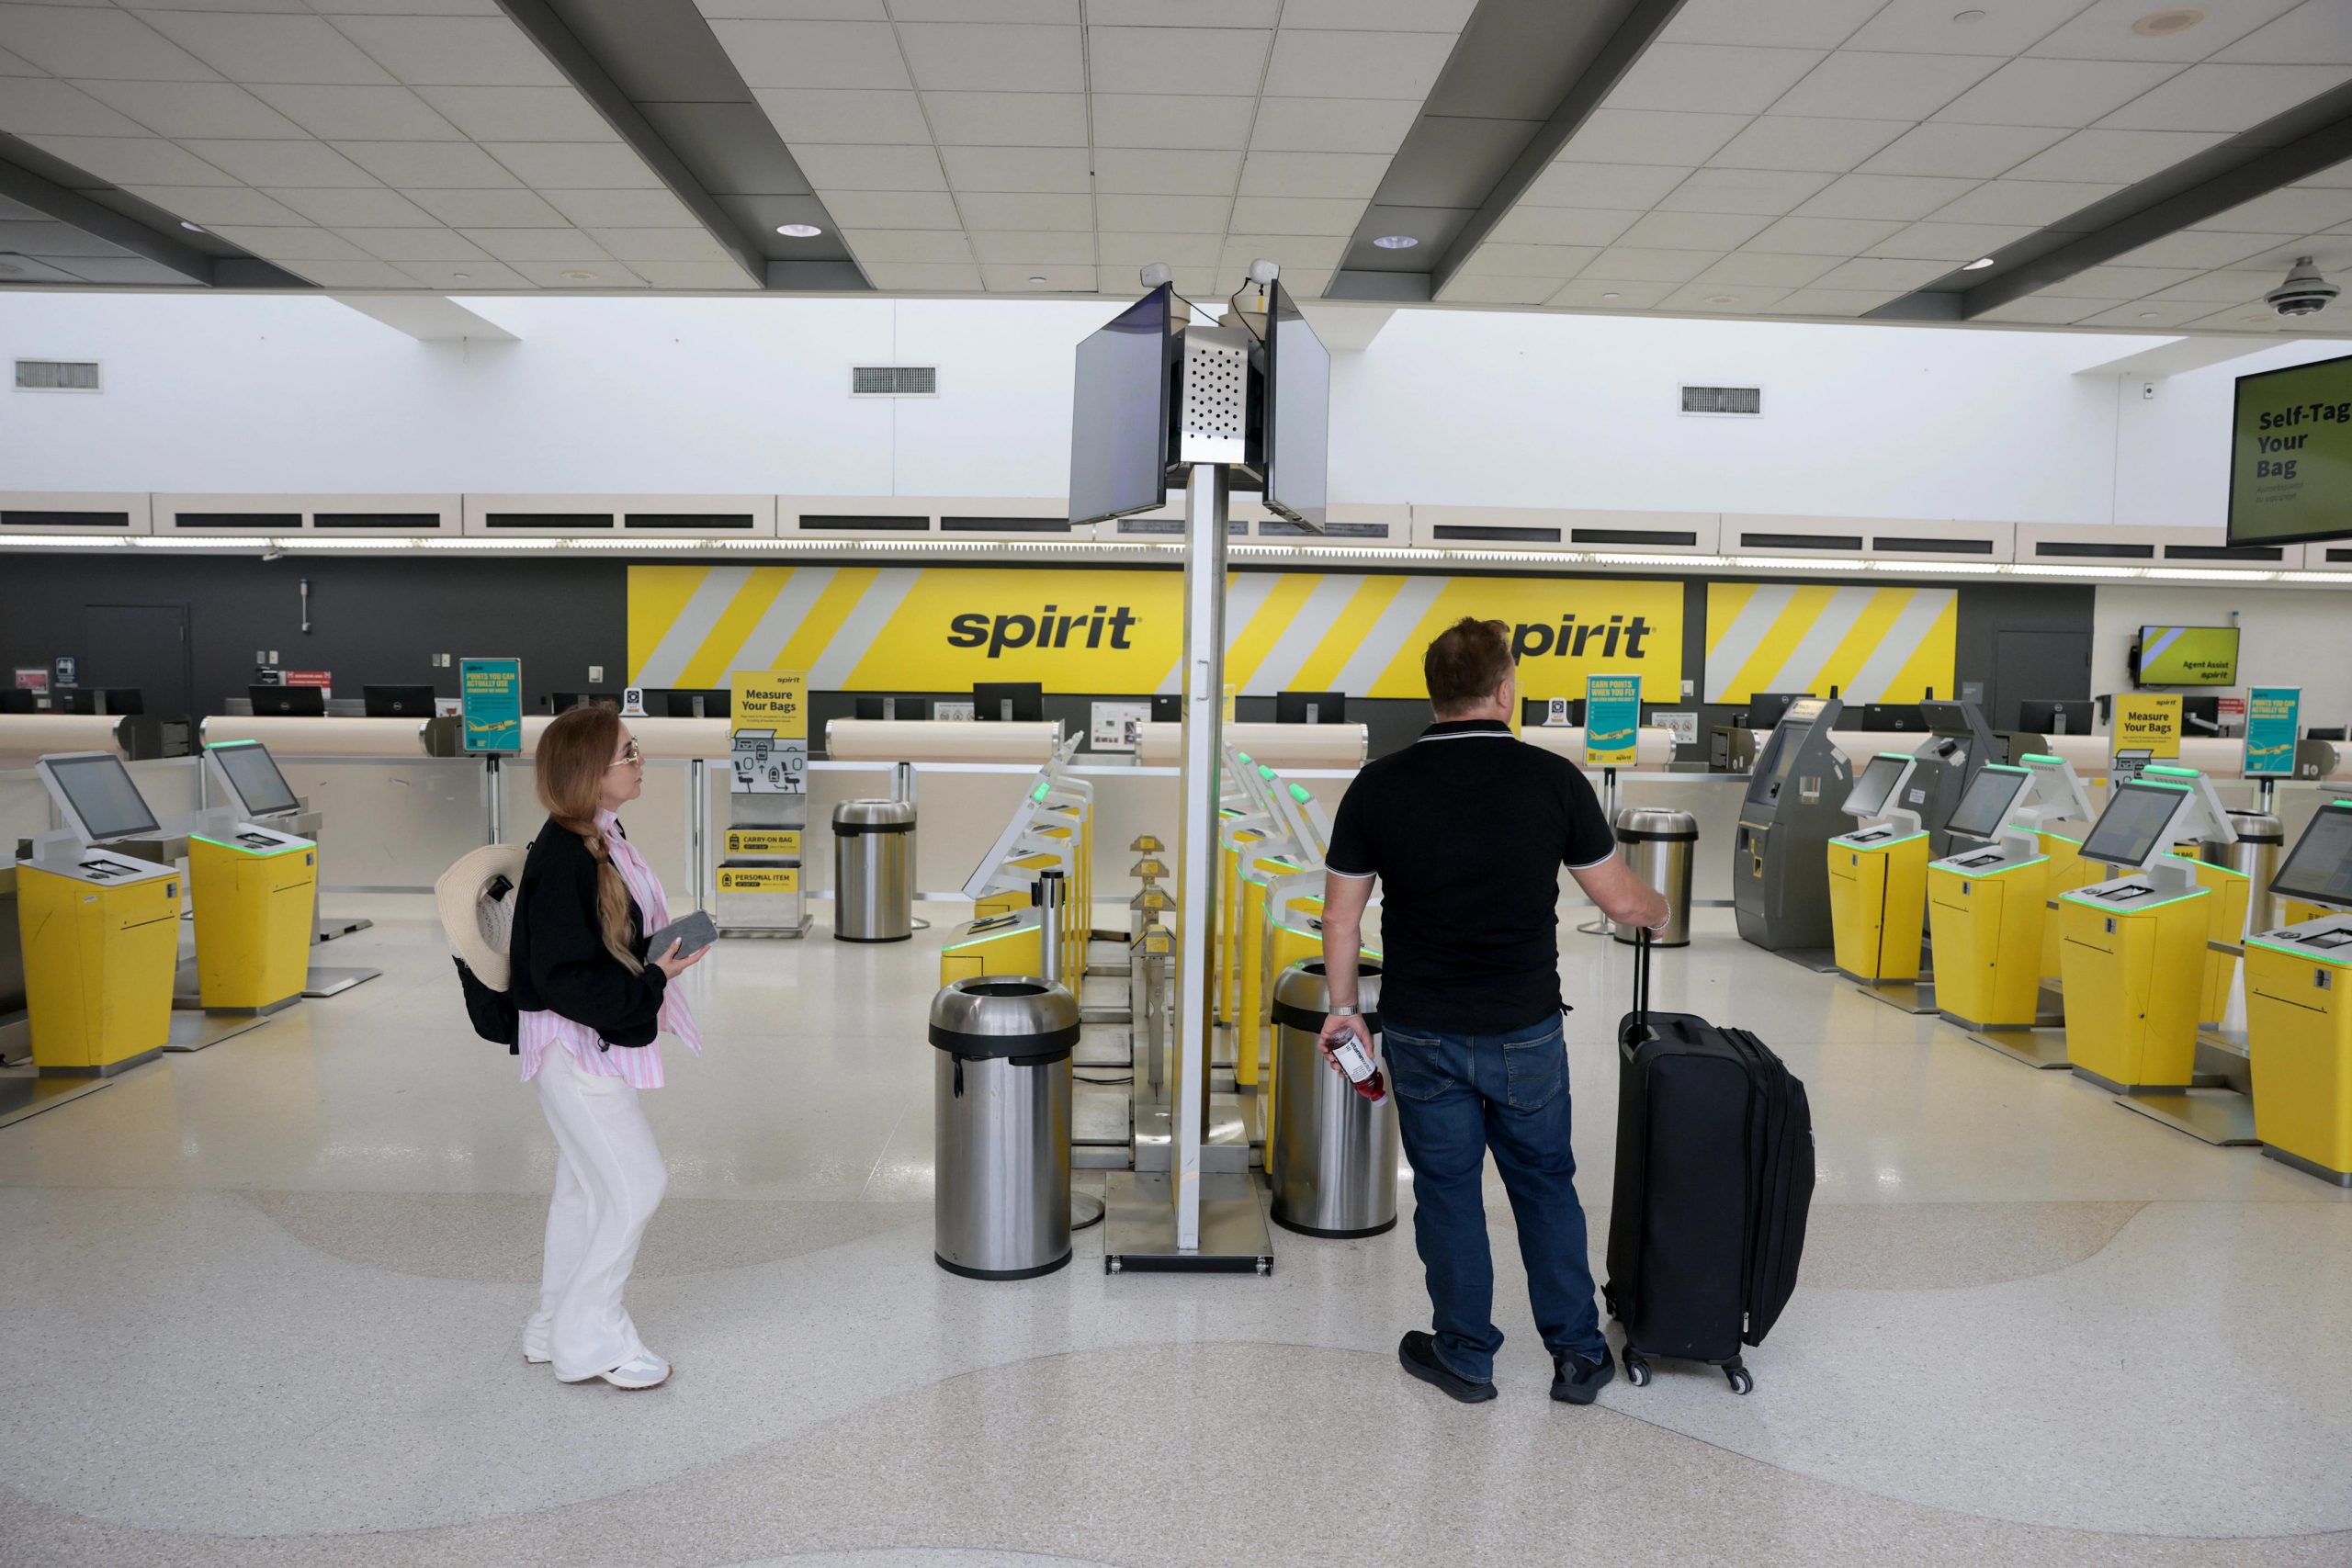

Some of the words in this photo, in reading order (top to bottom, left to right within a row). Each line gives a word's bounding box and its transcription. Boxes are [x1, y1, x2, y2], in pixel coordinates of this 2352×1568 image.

[2259, 402, 2352, 430] Self-Tag
[2257, 434, 2308, 454] Your
[2256, 460, 2297, 479] Bag
[947, 604, 1136, 658] spirit
[1507, 614, 1650, 666] pirit
[2183, 661, 2205, 670] Agent
[746, 690, 792, 699] Measure
[742, 701, 767, 710] Your
[770, 701, 796, 713] Bags
[2129, 712, 2169, 721] Measure
[2124, 723, 2146, 732] Your
[2149, 723, 2172, 734] Bags
